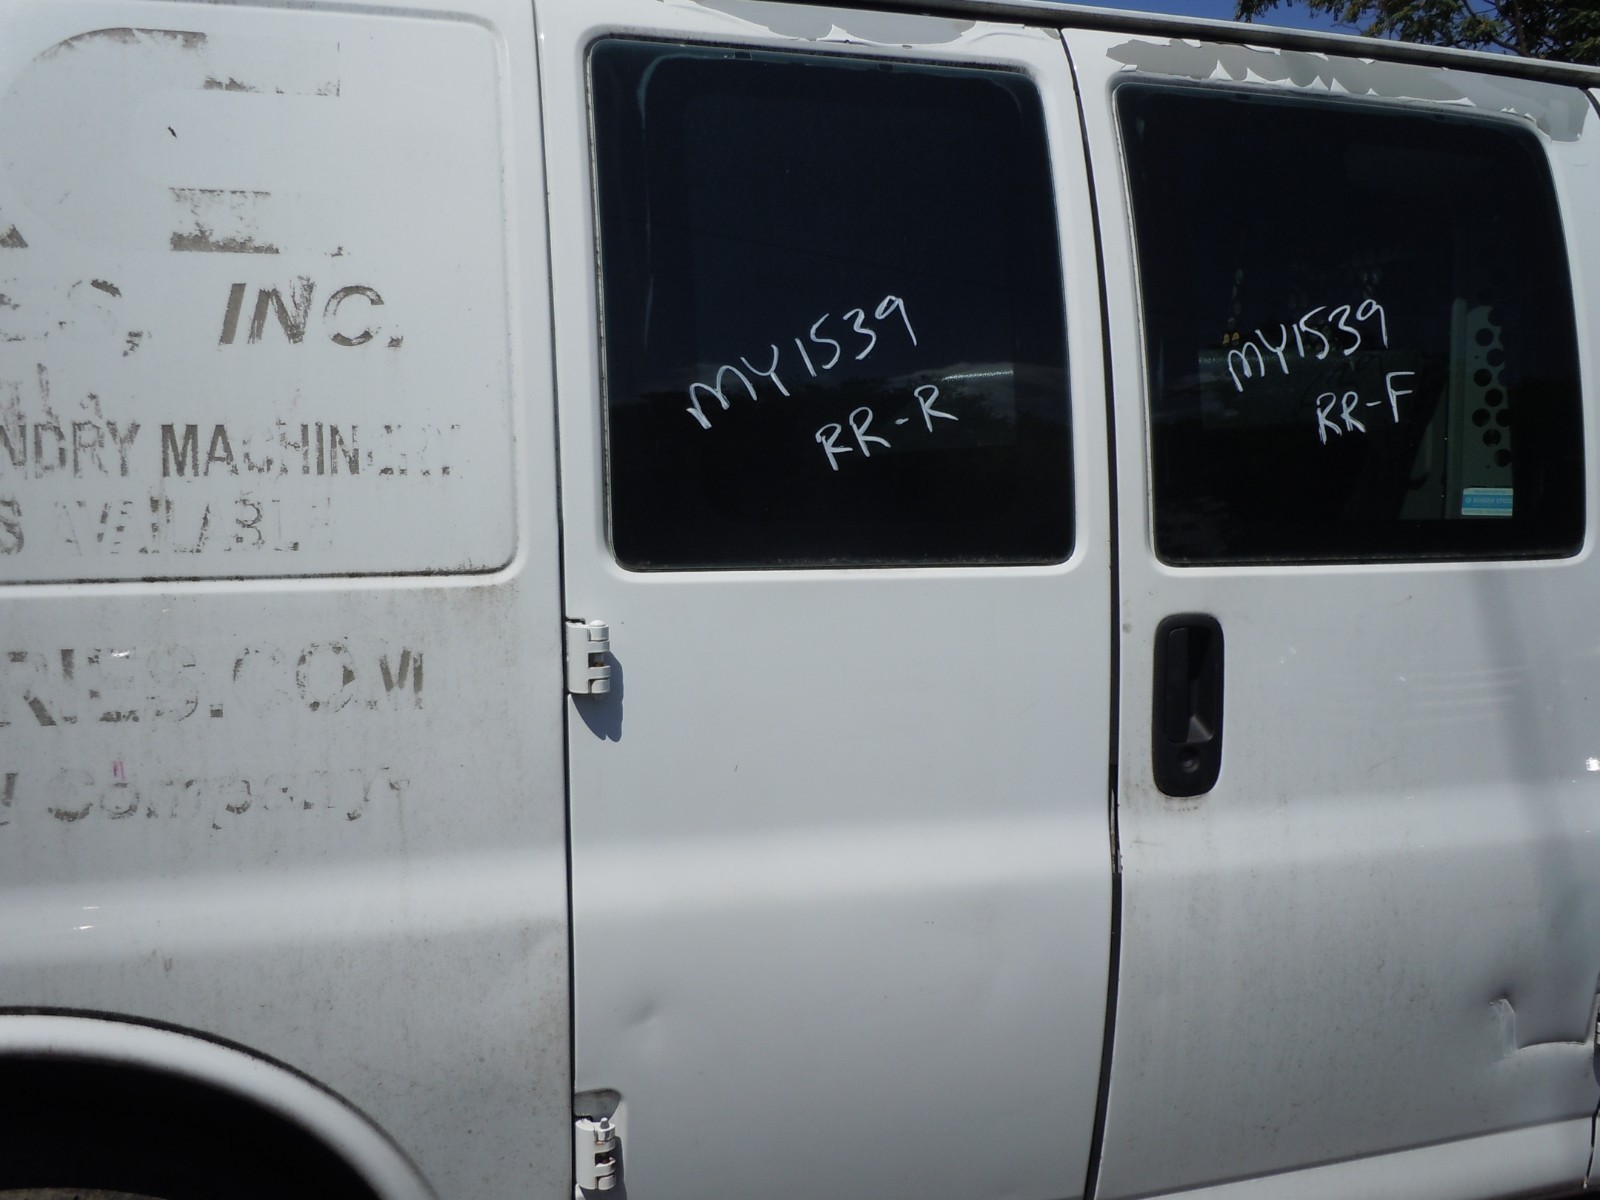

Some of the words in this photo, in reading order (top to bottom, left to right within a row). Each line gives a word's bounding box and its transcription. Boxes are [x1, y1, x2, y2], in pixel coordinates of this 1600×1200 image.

[217, 275, 404, 347] INC.
[1227, 299, 1389, 393] MY1539
[686, 295, 918, 430] MY1539
[815, 384, 959, 471] RR-R
[1316, 371, 1416, 445] RR-F
